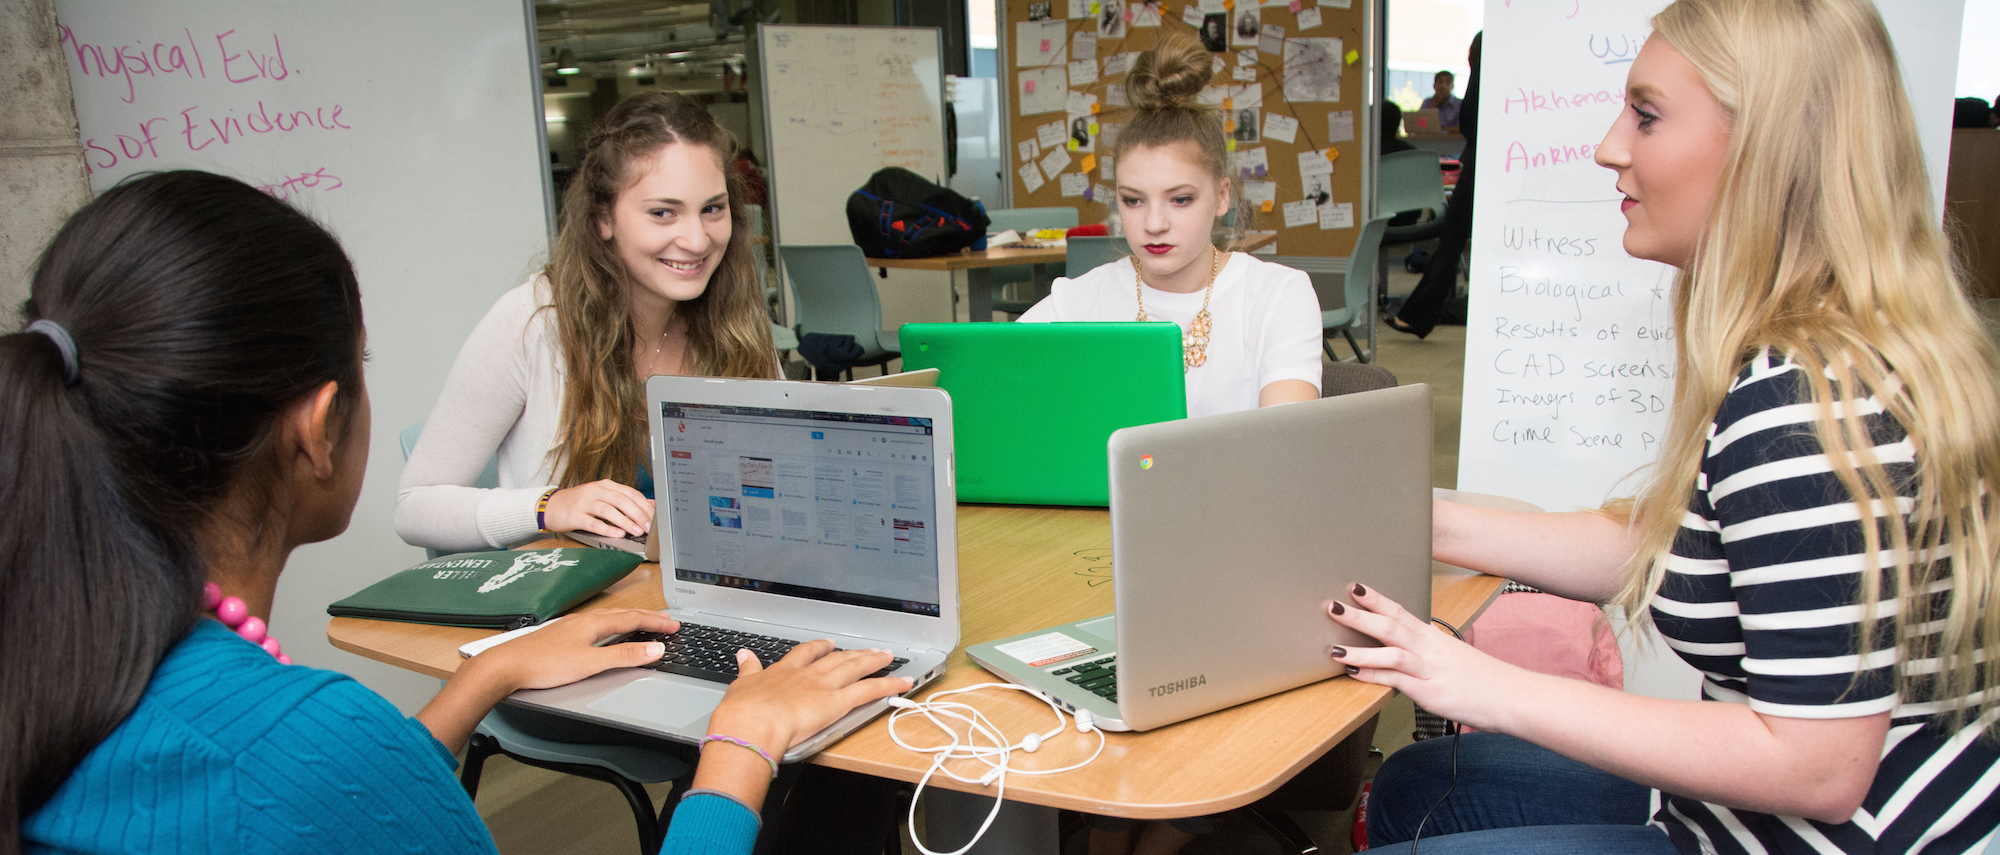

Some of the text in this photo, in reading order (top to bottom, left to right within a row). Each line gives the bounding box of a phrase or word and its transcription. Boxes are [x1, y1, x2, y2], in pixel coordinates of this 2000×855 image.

[1590, 33, 1646, 59] Wi
[180, 101, 351, 152] Evidence
[1503, 224, 1598, 257] Witness
[1498, 265, 1625, 323] Biological
[1494, 316, 1579, 340] Results
[1596, 323, 1620, 341] of
[1494, 348, 1566, 379] CAD
[1595, 387, 1623, 406] of
[1628, 388, 1665, 413] 3D
[1492, 419, 1556, 446] Crime
[1569, 425, 1623, 449] Scene
[955, 475, 985, 486] SHIBA
[412, 559, 498, 571] LEMENTAR
[433, 570, 484, 580] ILLER
[675, 587, 696, 595] TOSHIBA
[1148, 674, 1207, 698] TOSHIBA
